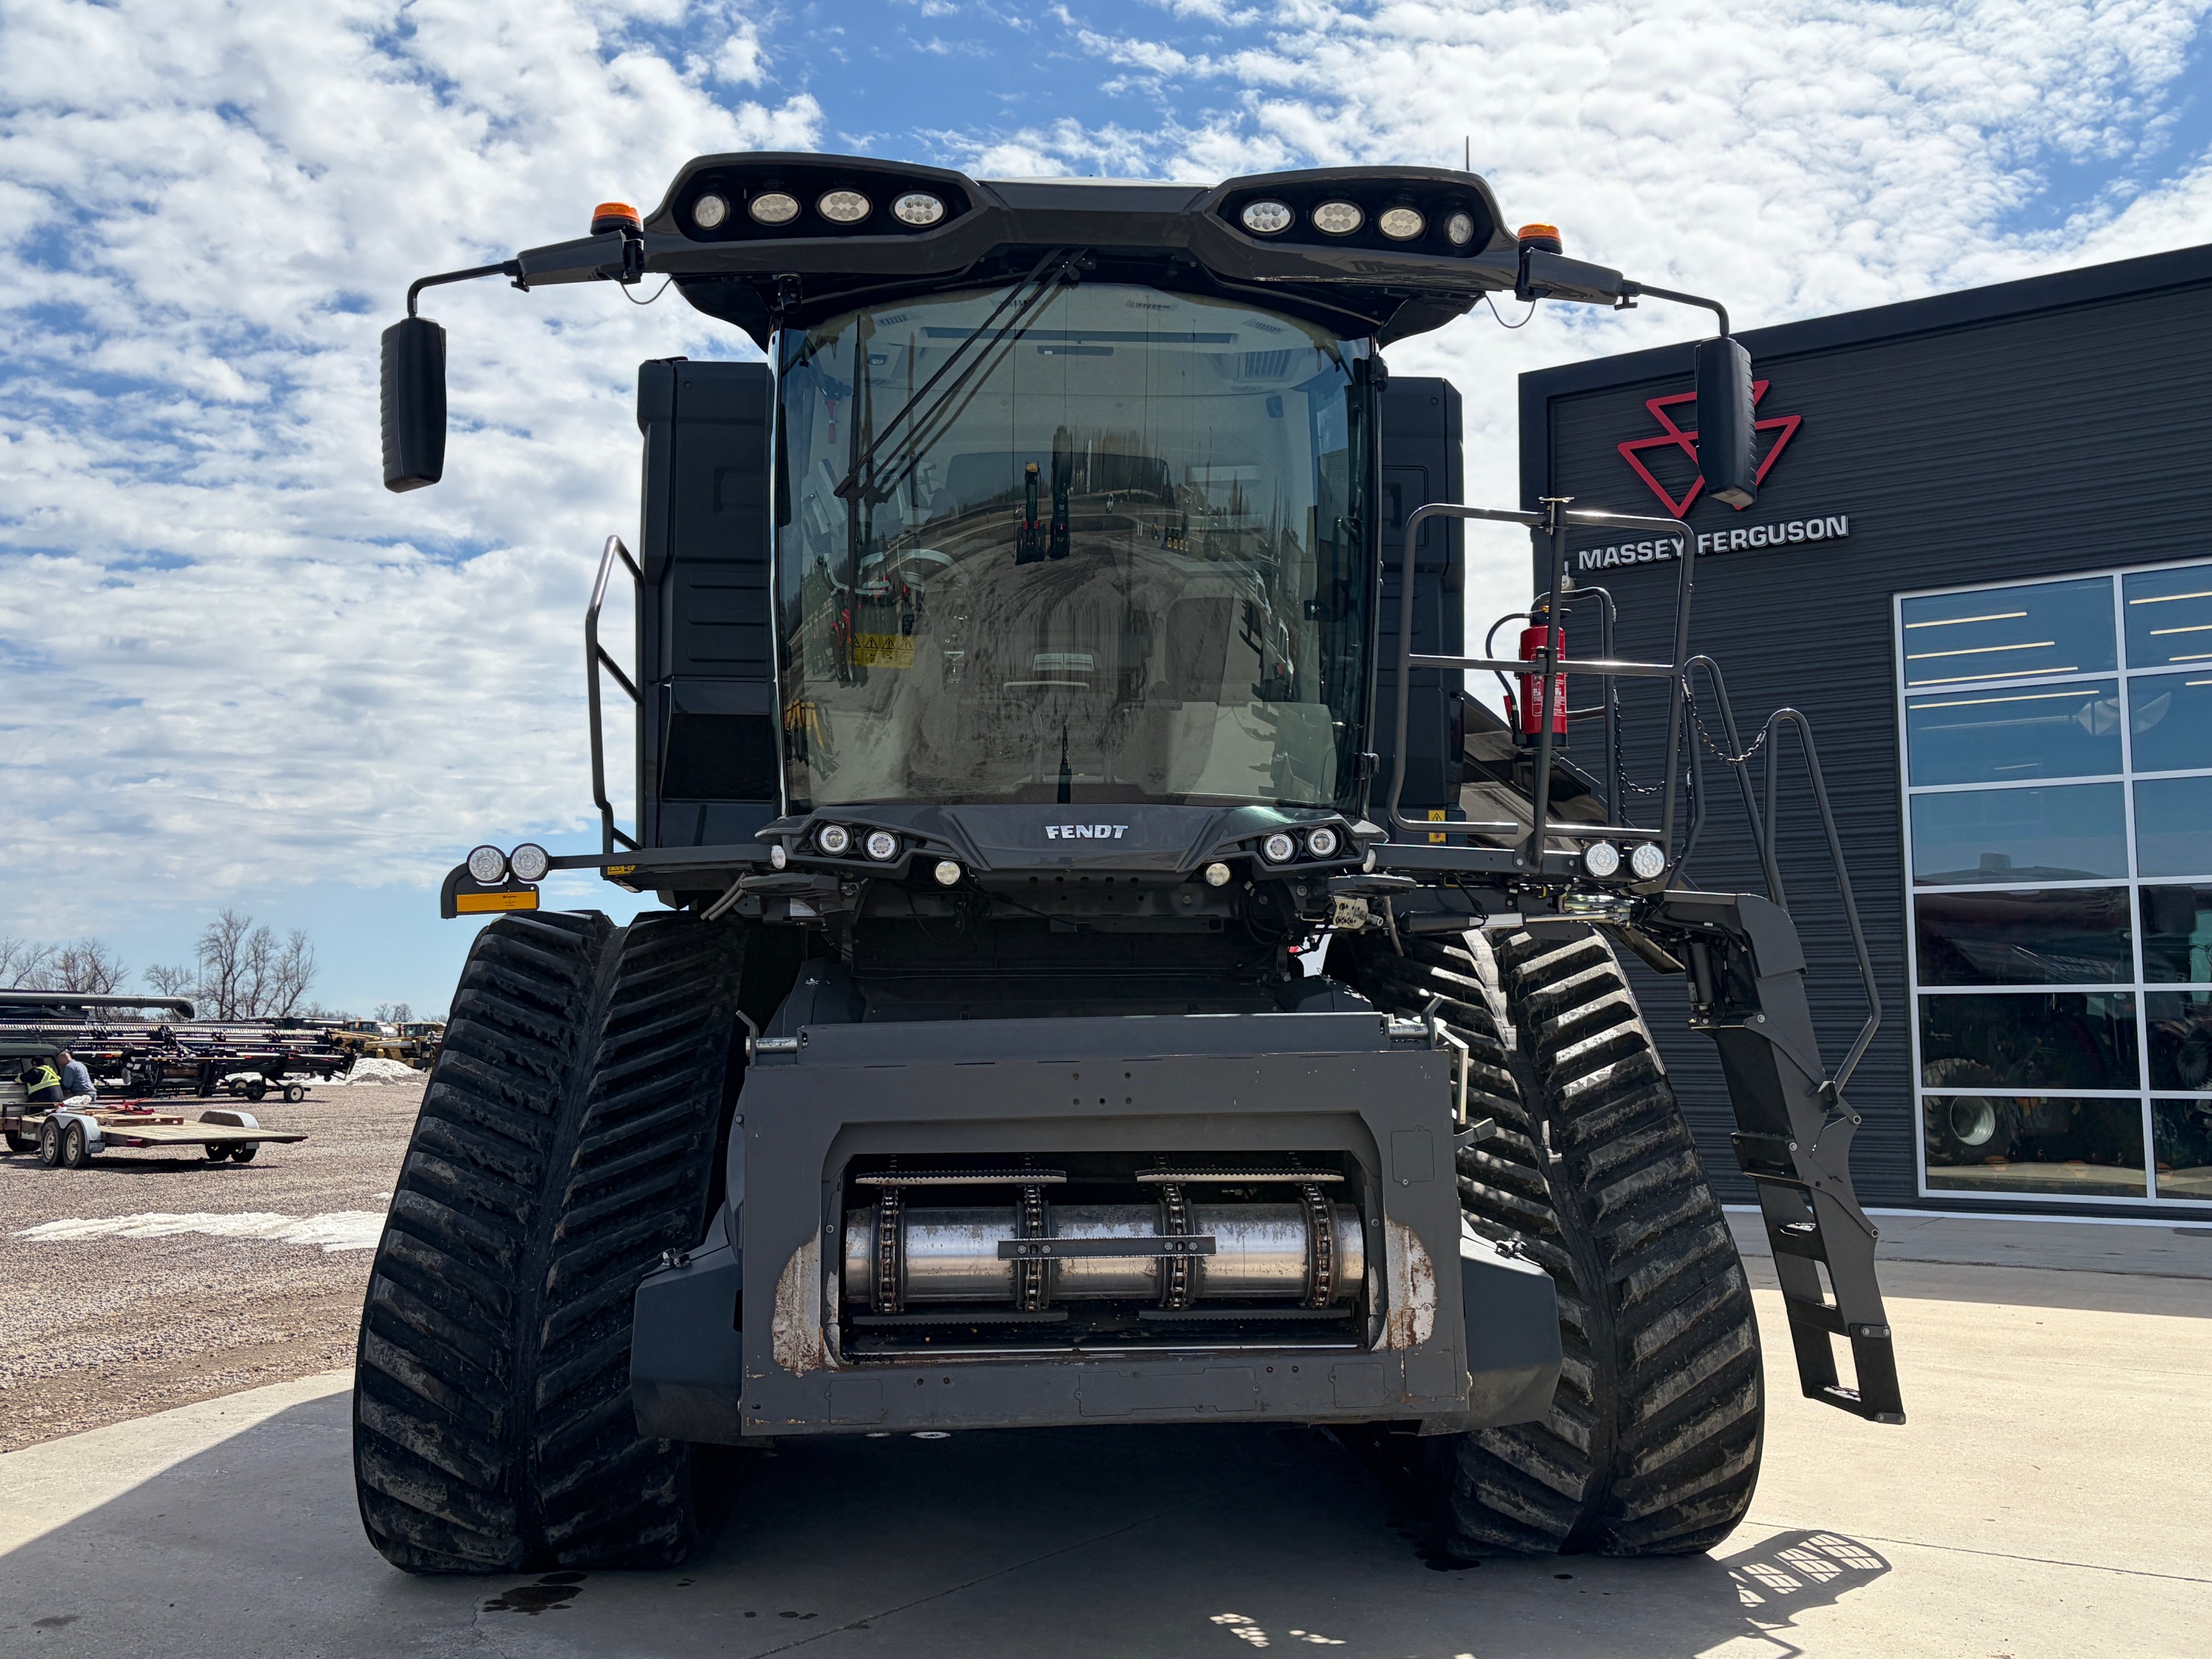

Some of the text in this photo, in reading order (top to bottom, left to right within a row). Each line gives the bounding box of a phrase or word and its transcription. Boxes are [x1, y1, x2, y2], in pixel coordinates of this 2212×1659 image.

[1578, 515, 1849, 570] MASSEY FERGUSON
[1045, 825, 1128, 839] FENDT
